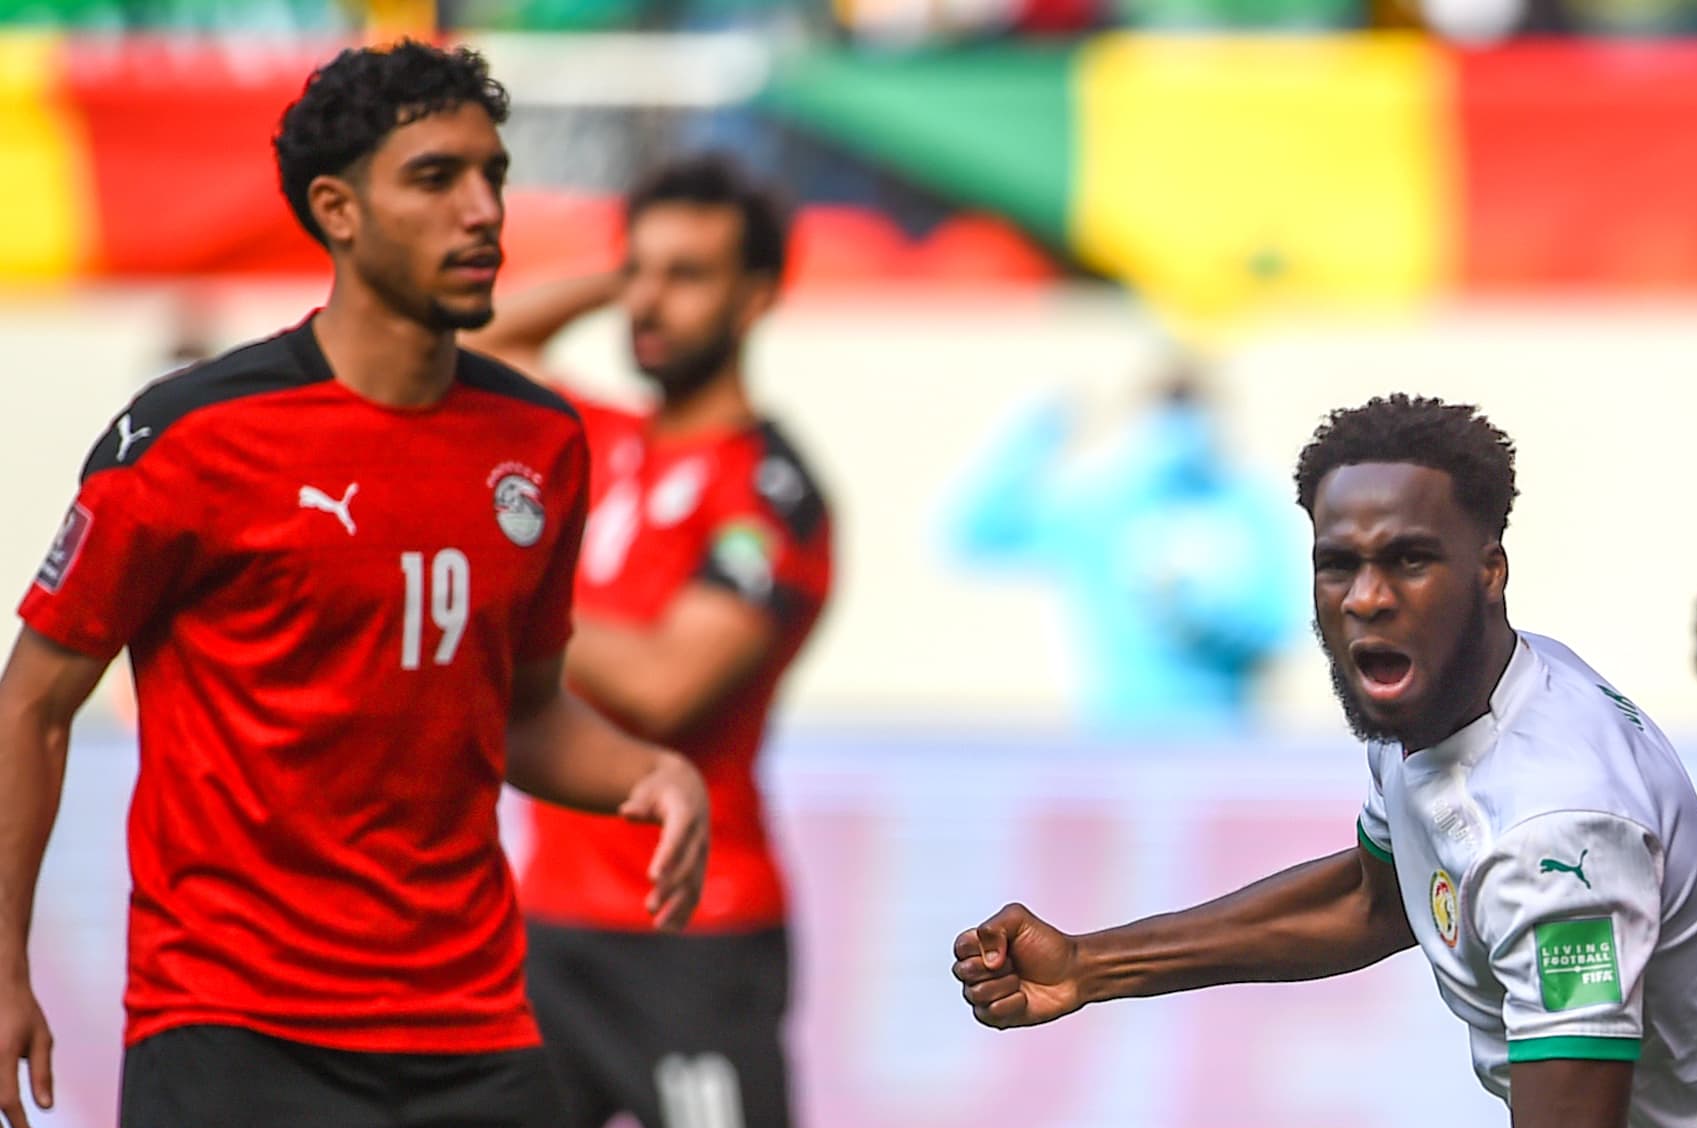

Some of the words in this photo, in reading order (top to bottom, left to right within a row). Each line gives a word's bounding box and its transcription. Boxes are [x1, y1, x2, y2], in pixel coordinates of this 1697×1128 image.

[400, 547, 470, 671] 19
[1541, 942, 1611, 957] LIVING
[1542, 952, 1612, 967] FOOTBALL
[1581, 970, 1613, 985] FIFA
